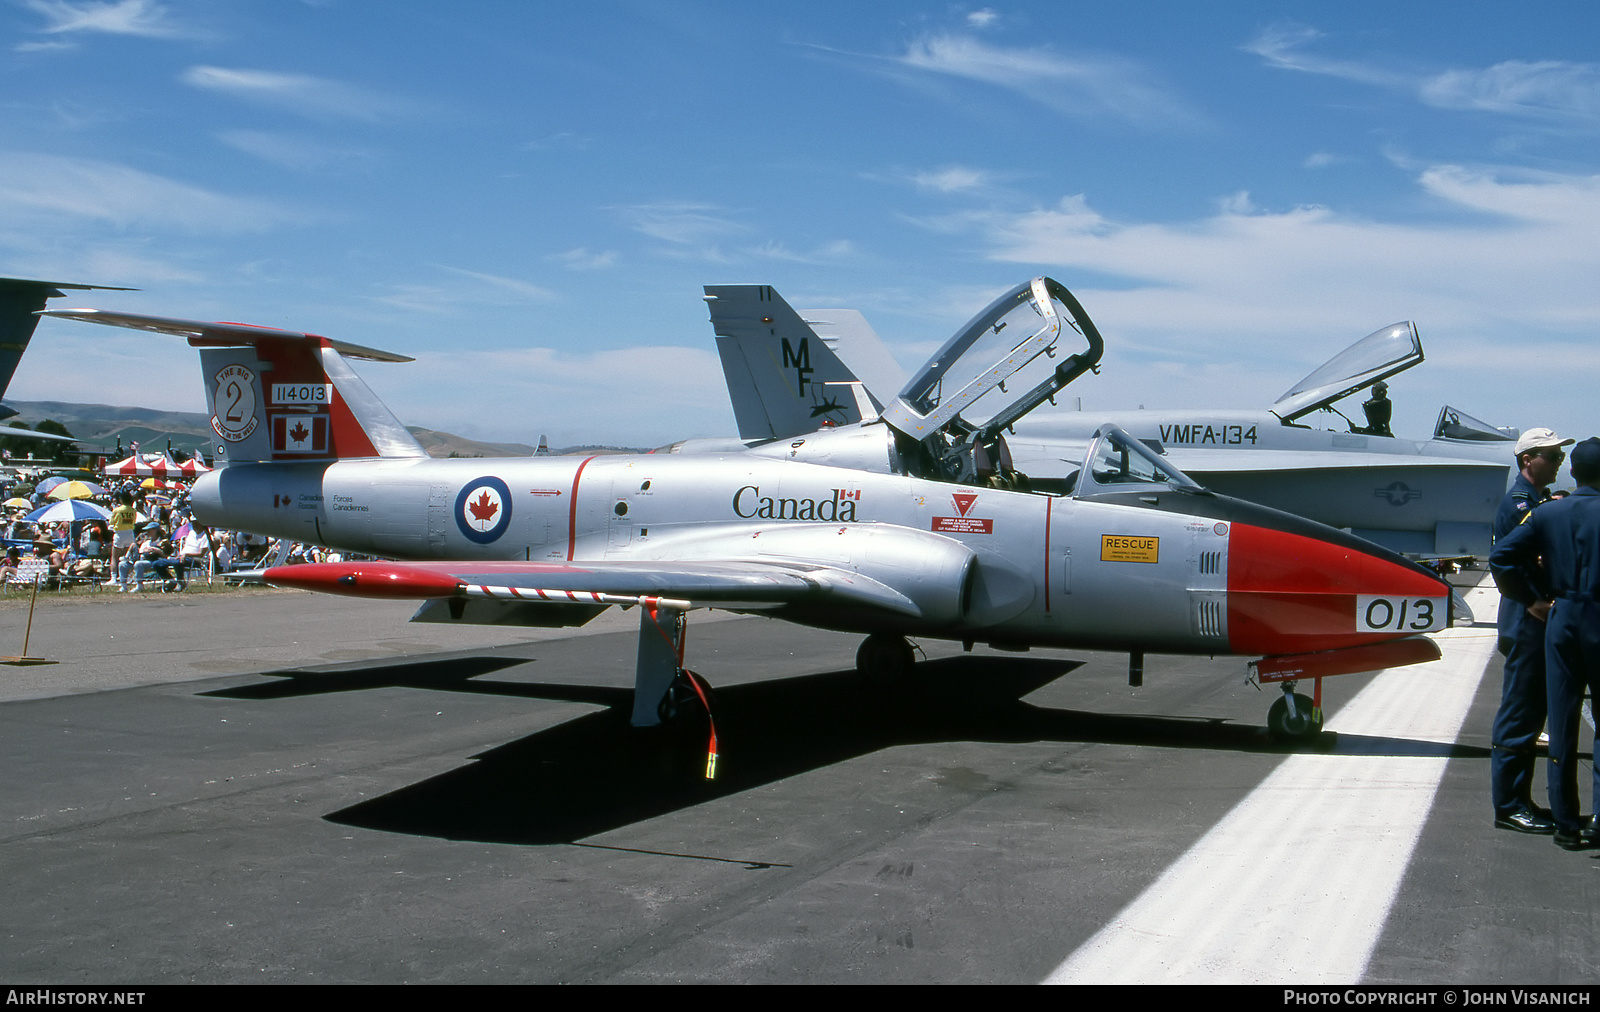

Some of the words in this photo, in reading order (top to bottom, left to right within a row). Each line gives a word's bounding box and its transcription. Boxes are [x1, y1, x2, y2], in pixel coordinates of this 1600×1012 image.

[220, 367, 235, 381] THE
[237, 367, 250, 381] BIG
[226, 381, 244, 422] 2
[277, 386, 325, 401] 114013
[214, 421, 226, 436] BEST
[243, 421, 255, 437] WEST
[1159, 424, 1258, 445] VMFA-134
[333, 494, 353, 503] Forces
[732, 485, 859, 523] Canada
[1106, 538, 1154, 549] RESCUE
[1365, 598, 1434, 630] 013
